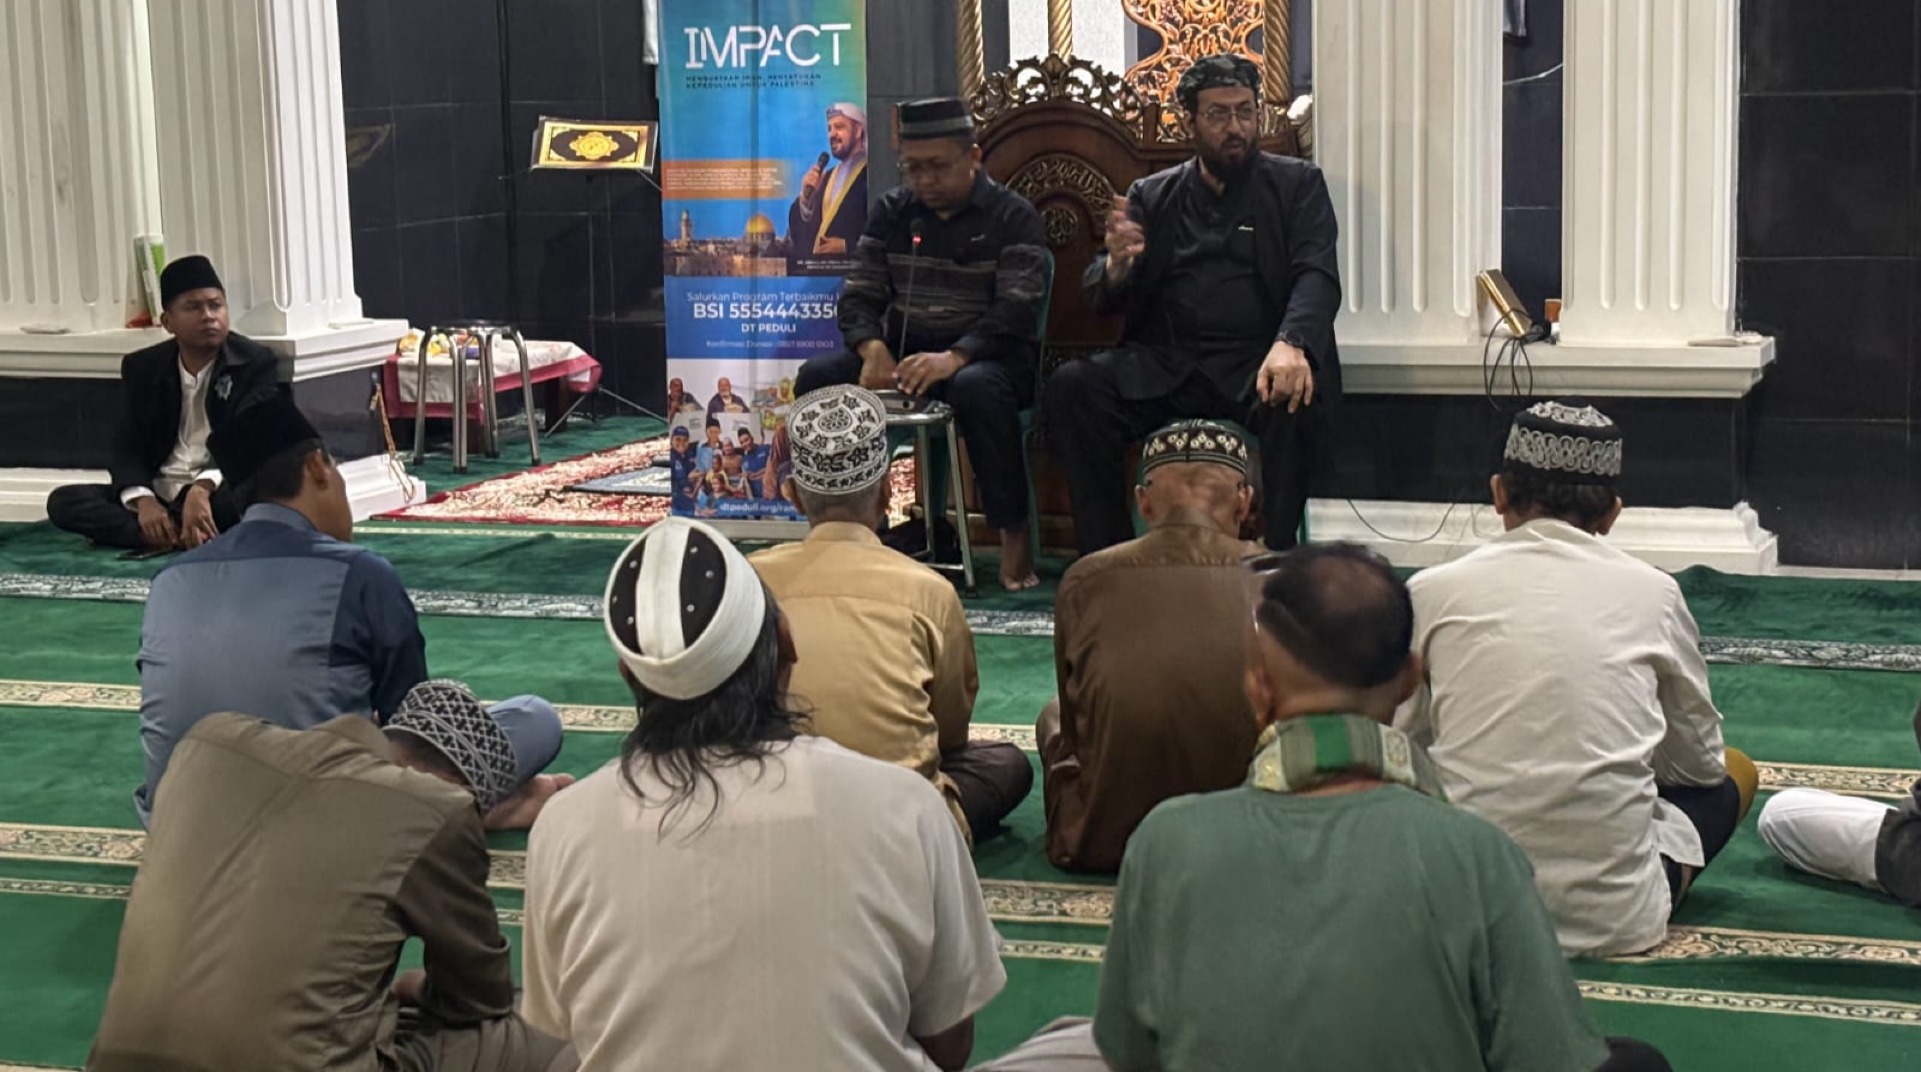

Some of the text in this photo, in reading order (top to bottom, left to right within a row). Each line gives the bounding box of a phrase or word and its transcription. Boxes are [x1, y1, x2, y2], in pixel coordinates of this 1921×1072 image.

[684, 23, 852, 69] IMPACT
[687, 291, 730, 302] Salurkan
[733, 291, 778, 303] Program
[781, 291, 834, 301] Terbaikmu
[694, 302, 724, 319] BSI
[741, 322, 796, 333] DT PEDULI
